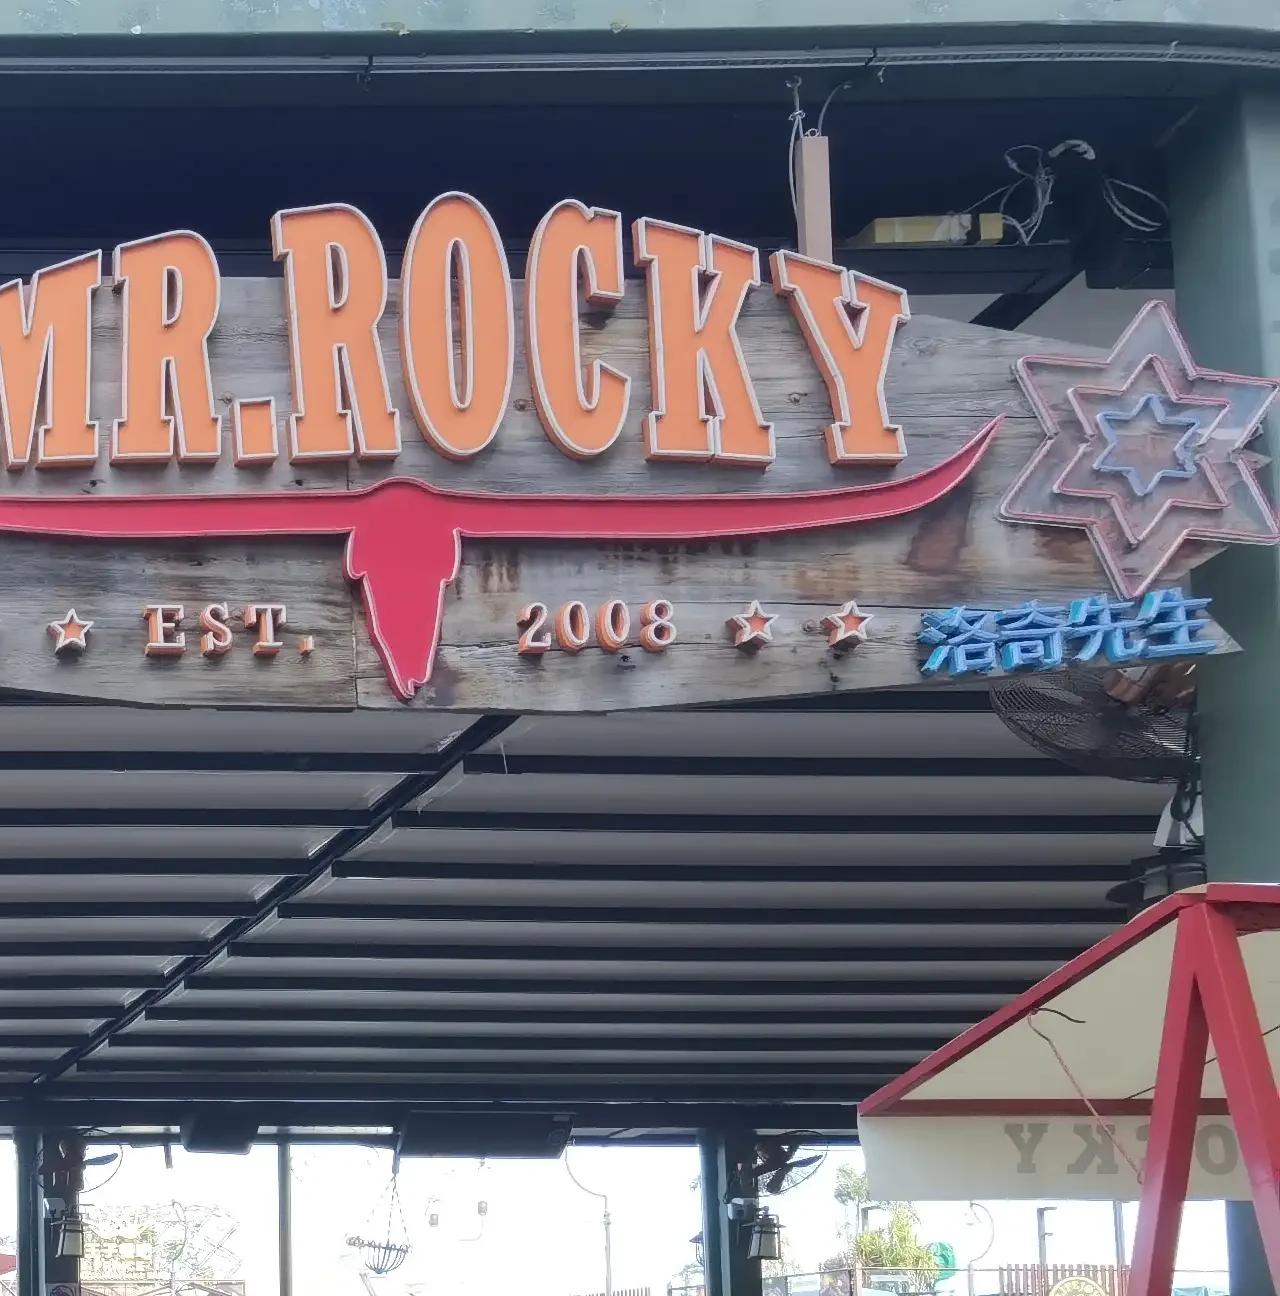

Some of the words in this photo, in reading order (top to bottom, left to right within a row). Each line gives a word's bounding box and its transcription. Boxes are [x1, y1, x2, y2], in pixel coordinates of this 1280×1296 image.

[143, 601, 315, 658] EST.
[516, 599, 677, 656] 2008
[917, 587, 1219, 676] 洛奇先生
